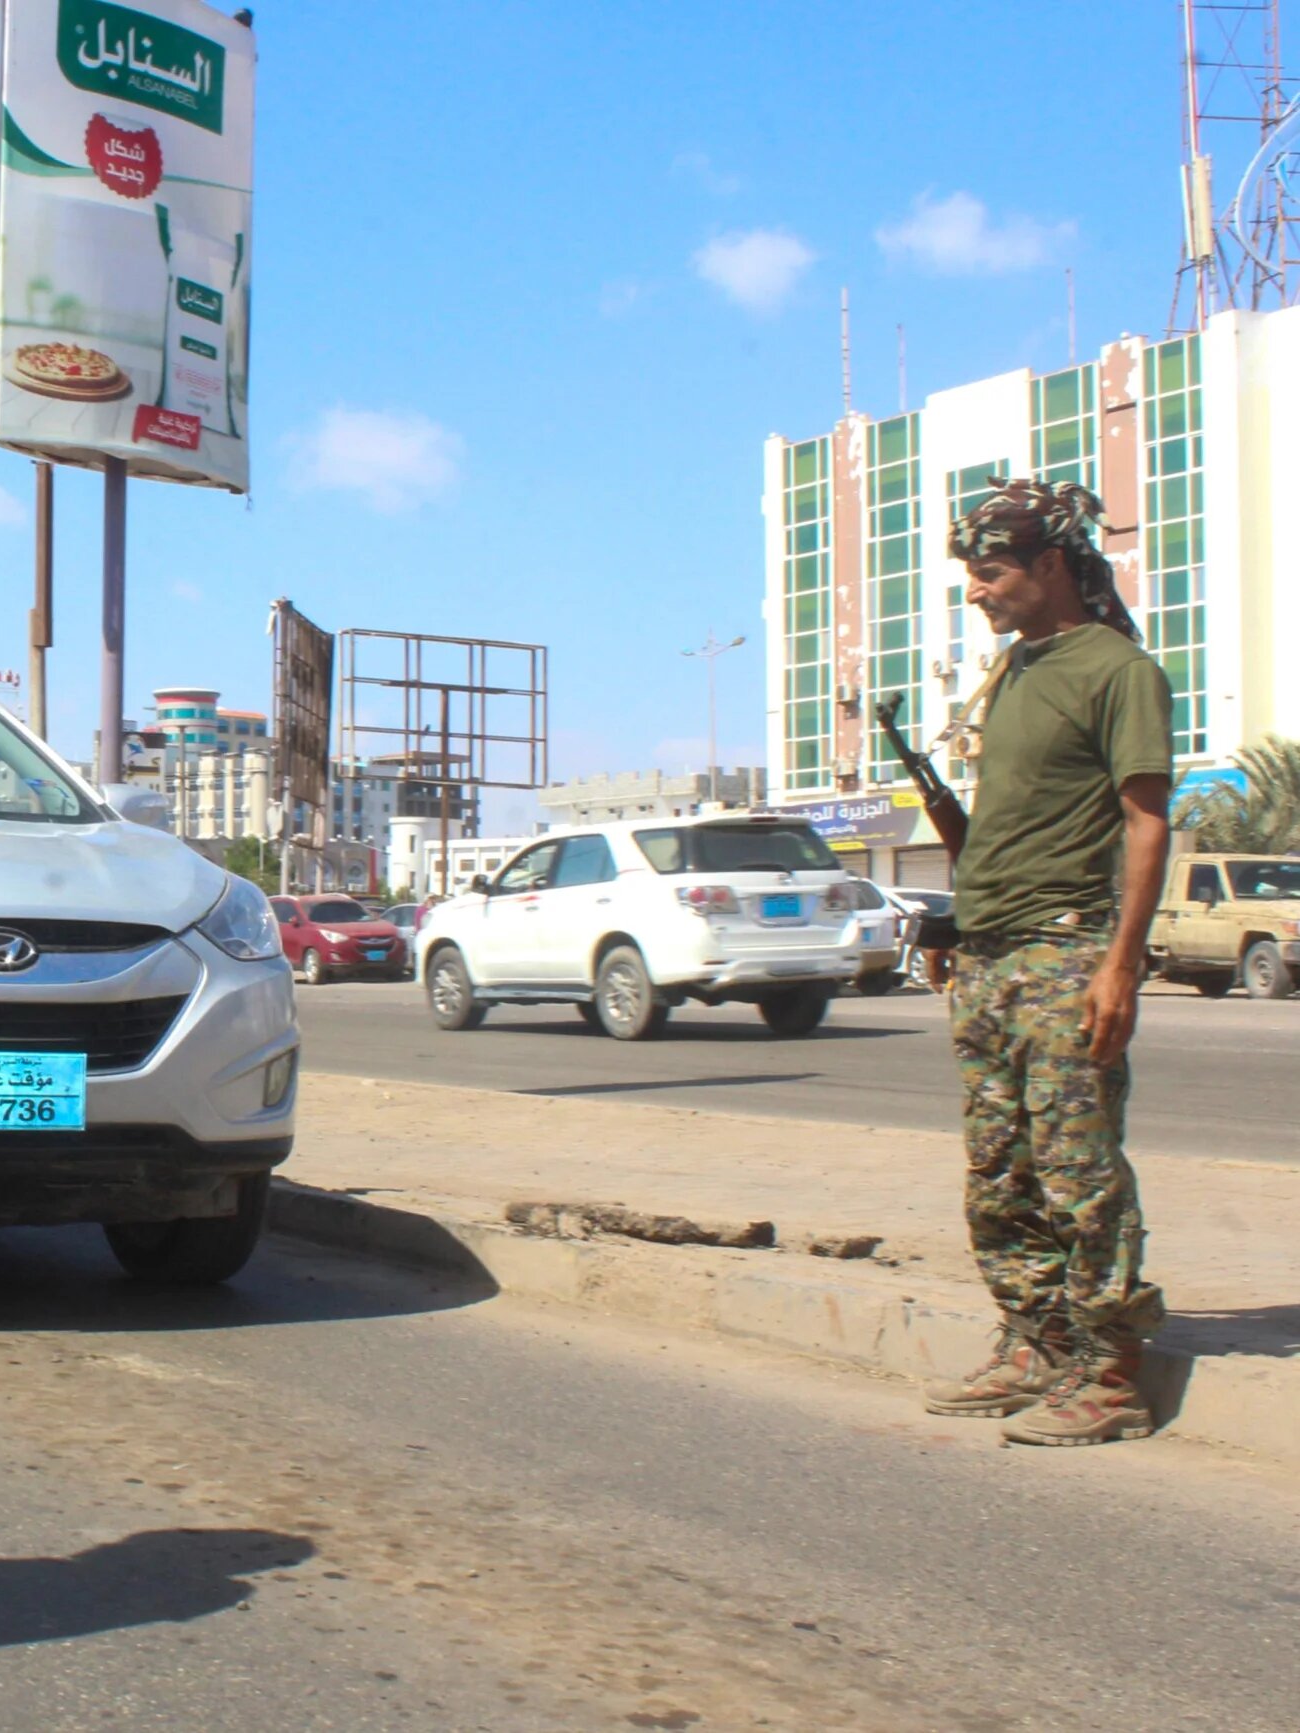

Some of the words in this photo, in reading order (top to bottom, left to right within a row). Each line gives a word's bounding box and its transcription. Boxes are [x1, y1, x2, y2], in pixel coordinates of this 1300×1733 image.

[78, 18, 211, 96] السنابل
[127, 74, 198, 110] ALSANABEL
[104, 138, 145, 161] شكل
[105, 162, 145, 185] جديد
[838, 800, 890, 820] الجزيرة
